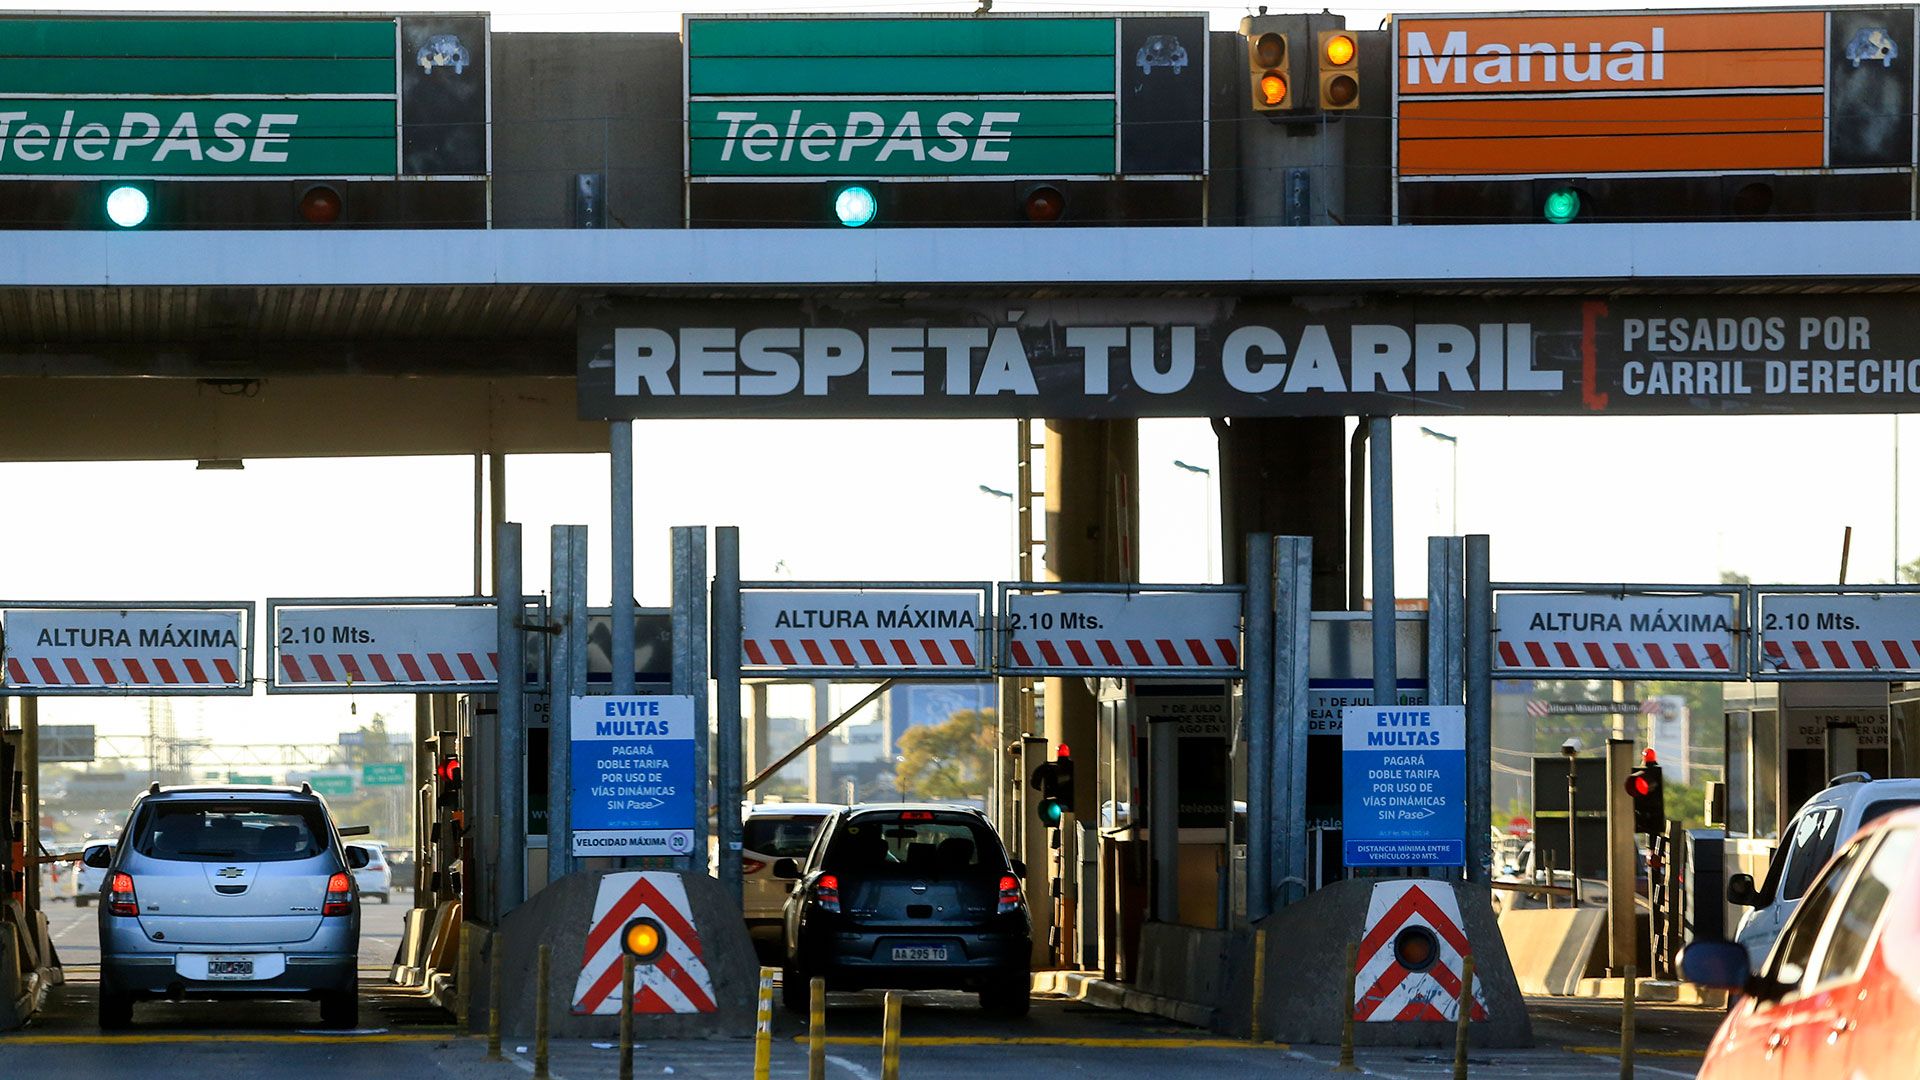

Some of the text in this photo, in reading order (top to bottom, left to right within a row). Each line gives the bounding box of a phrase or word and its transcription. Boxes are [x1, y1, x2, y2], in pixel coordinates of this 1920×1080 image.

[1406, 28, 1664, 85] Manual
[716, 109, 1020, 162] TelePASE
[1623, 316, 1870, 351] PESADOS POR
[615, 310, 1563, 396] RESPETÁ TU CARRIL
[1623, 359, 1920, 396] CARRIL DERECHO
[775, 604, 974, 629] ALTURA MÁXIMA
[1011, 612, 1103, 630] 2.10 Mts.
[1530, 608, 1727, 633] ALTURA MÁXIMA
[1766, 612, 1860, 631] 2.10 Mts.
[37, 624, 238, 648] ALTURA MÁXIMA
[281, 626, 376, 644] 2.10 Mts.
[1331, 697, 1348, 707] DE
[605, 702, 659, 716] EVITE
[1172, 704, 1186, 713] DE
[1309, 720, 1326, 730] DE
[1377, 712, 1431, 727] EVITE
[596, 721, 669, 736] MULTAS
[1368, 731, 1440, 746] MULTAS
[1806, 736, 1821, 745] DE
[612, 744, 654, 755] PAGARÁ
[597, 760, 669, 769] DOBLE TARIFA
[1383, 754, 1425, 766] PAGARÁ
[602, 773, 662, 783] POR USO DE
[1368, 770, 1441, 779] DOBLE TARIFA
[591, 785, 675, 796] VÍAS DINÁMICAS
[1373, 783, 1433, 793] POR USO DE
[607, 800, 653, 810] SIN Pase
[1362, 795, 1446, 806] VÍAS DINÁMICAS
[1378, 810, 1424, 820] SIN Pase
[576, 836, 684, 847] VELOCIDAD MÁXIMA 20
[1357, 845, 1397, 853] DISTANCIA
[1397, 844, 1426, 852] MÍNIMA
[1369, 852, 1410, 860] VEHÍCULOS
[895, 949, 907, 959] AA
[910, 949, 929, 959] 295
